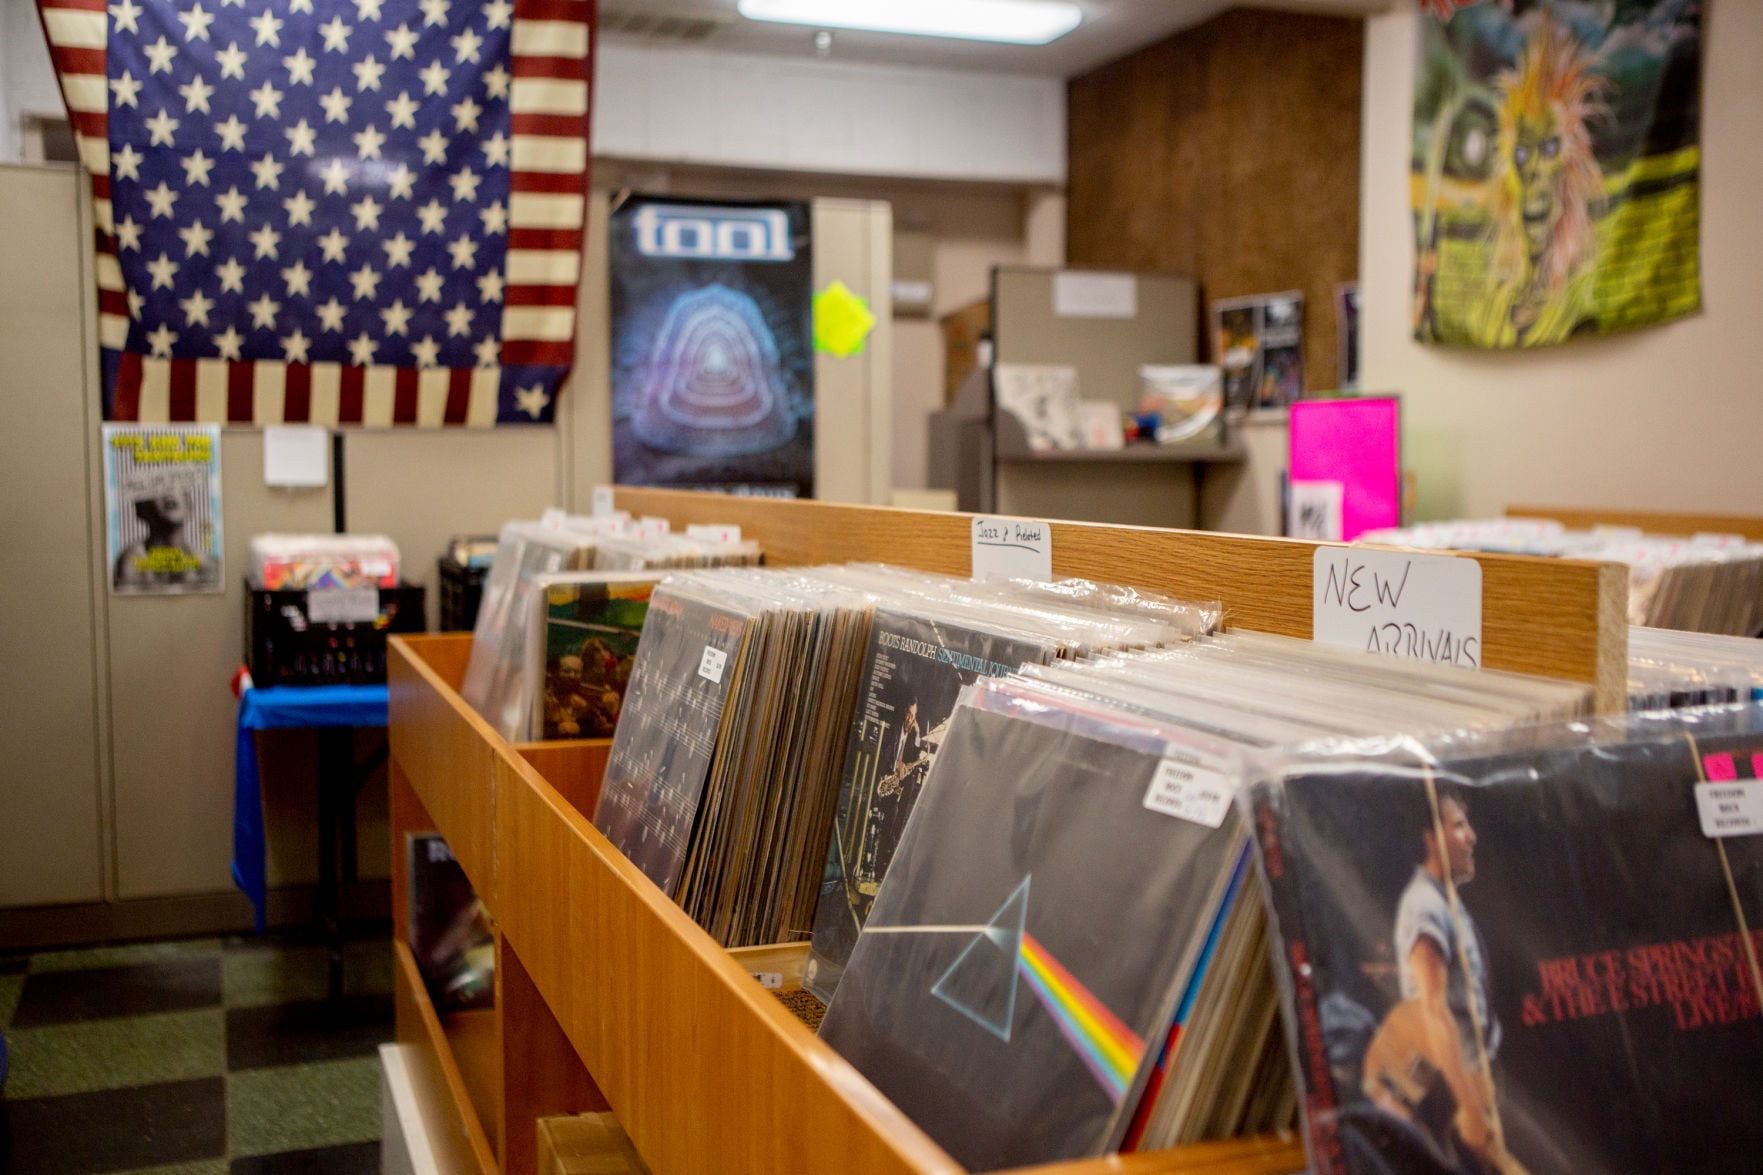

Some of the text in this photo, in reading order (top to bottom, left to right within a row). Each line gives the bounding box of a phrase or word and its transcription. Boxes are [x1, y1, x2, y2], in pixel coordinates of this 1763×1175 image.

[634, 204, 796, 262] tool
[977, 520, 999, 538] Jazz
[1016, 524, 1041, 542] Related
[1324, 557, 1412, 612] NEW
[900, 635, 938, 660] RANDOLPH
[938, 647, 988, 675] SENTIMENTAL
[1538, 950, 1621, 997] BRUCE
[1521, 991, 1546, 1026] &
